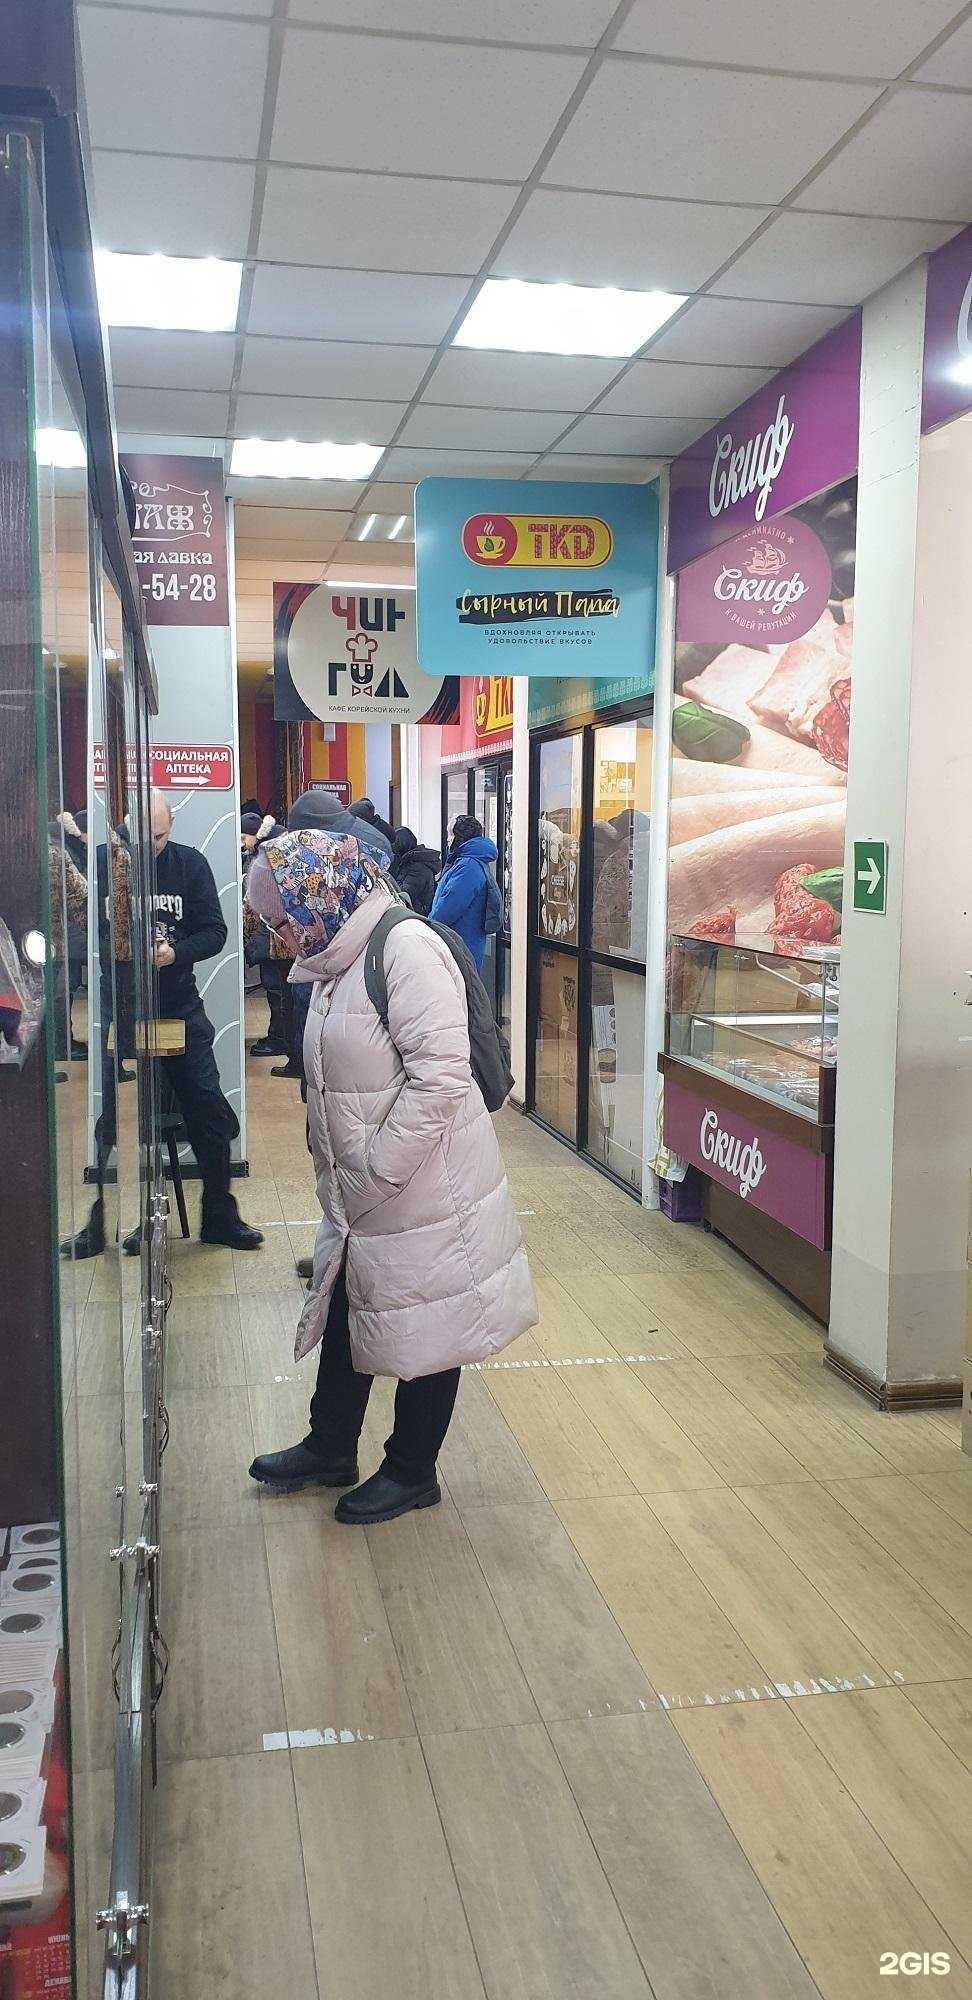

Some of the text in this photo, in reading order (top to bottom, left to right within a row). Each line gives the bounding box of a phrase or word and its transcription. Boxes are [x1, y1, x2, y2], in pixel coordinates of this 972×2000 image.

[709, 394, 795, 522] Скиф
[141, 573, 217, 602] -54-28
[713, 564, 810, 615] Скиф
[461, 588, 620, 618] Сырный Папа
[328, 705, 346, 713] КАФЕ
[165, 763, 211, 774] АПТЕКА
[699, 1107, 767, 1199] Скиф
